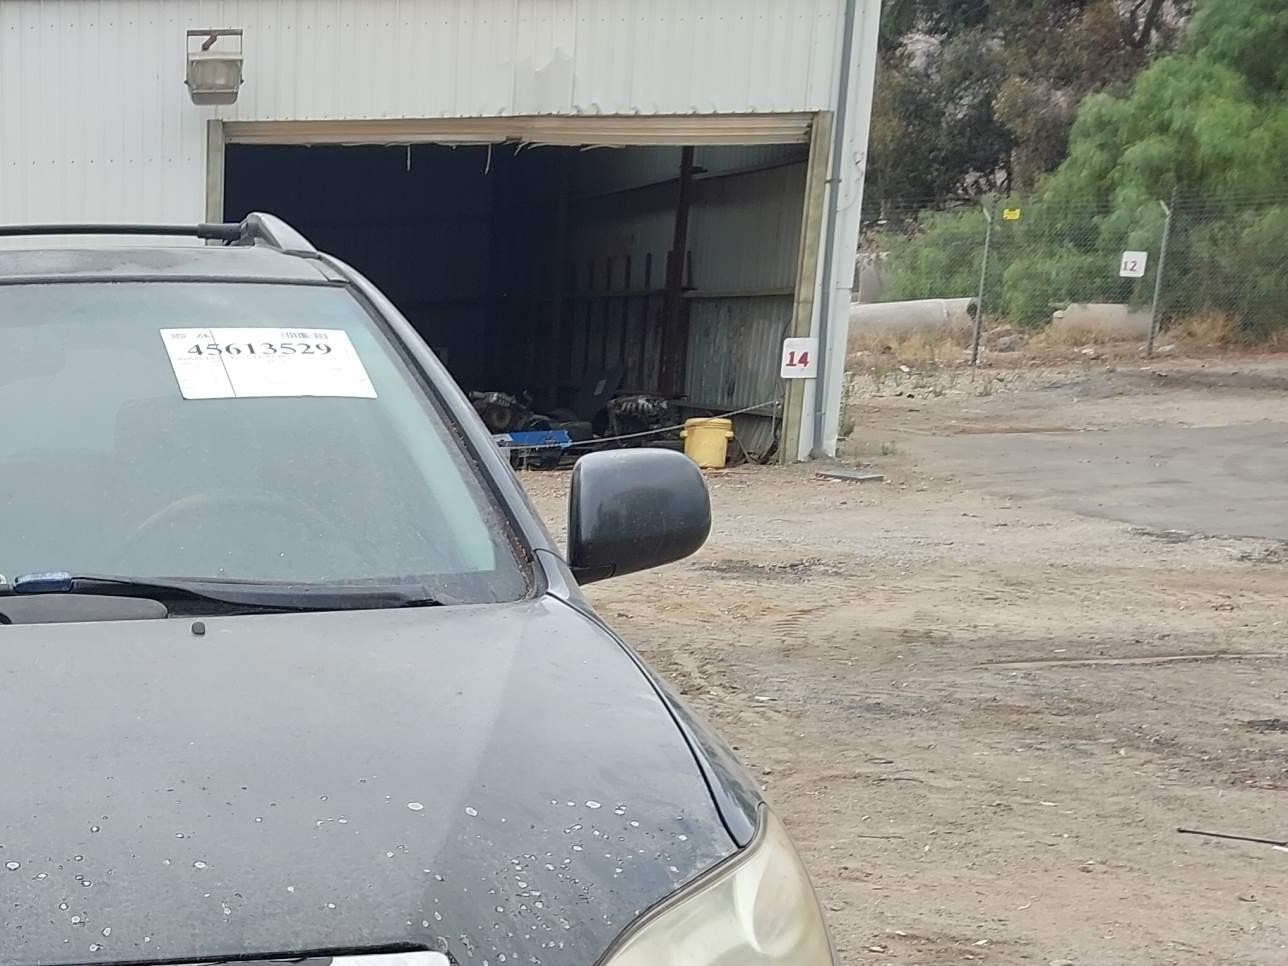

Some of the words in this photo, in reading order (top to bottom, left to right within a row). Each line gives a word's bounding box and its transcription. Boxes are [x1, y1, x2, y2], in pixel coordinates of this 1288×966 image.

[1123, 260, 1137, 272] 12
[187, 343, 332, 356] 45613529
[785, 351, 809, 367] 14
